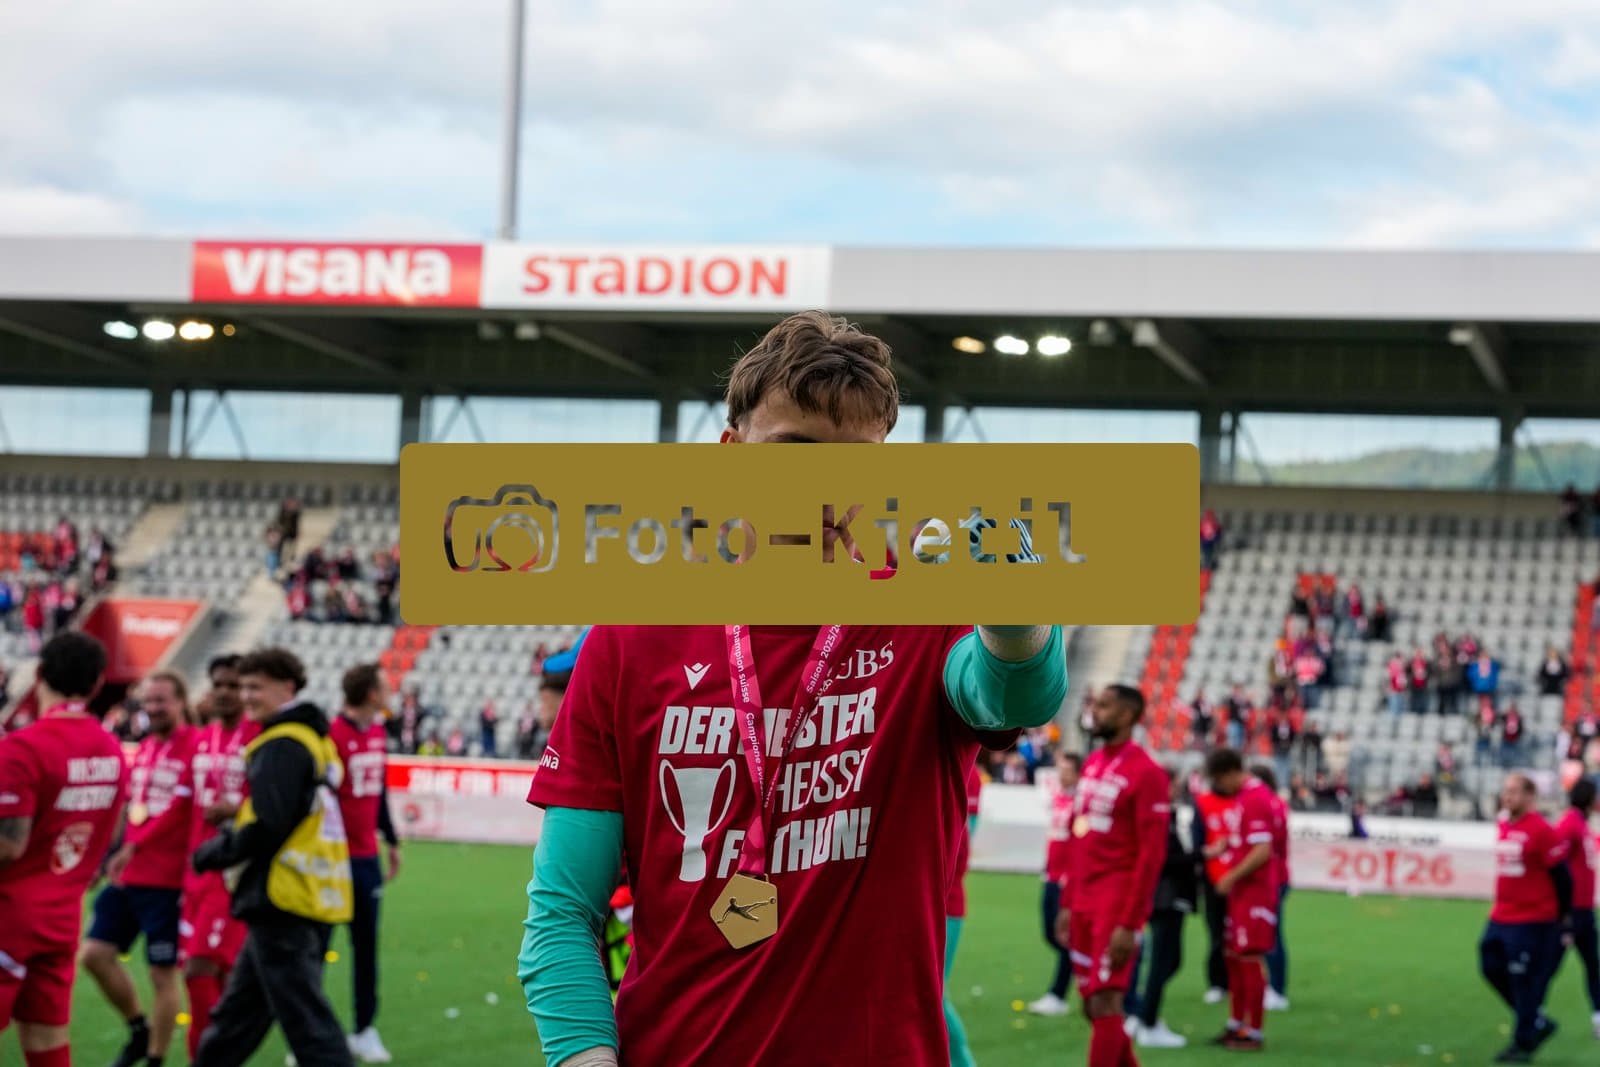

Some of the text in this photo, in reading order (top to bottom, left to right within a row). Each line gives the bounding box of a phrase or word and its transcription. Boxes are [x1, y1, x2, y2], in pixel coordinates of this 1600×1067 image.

[806, 660, 826, 694] Saison
[658, 705, 736, 755] DER
[739, 673, 750, 704] suisse
[746, 712, 761, 764] Campione
[771, 806, 871, 875] THUN!
